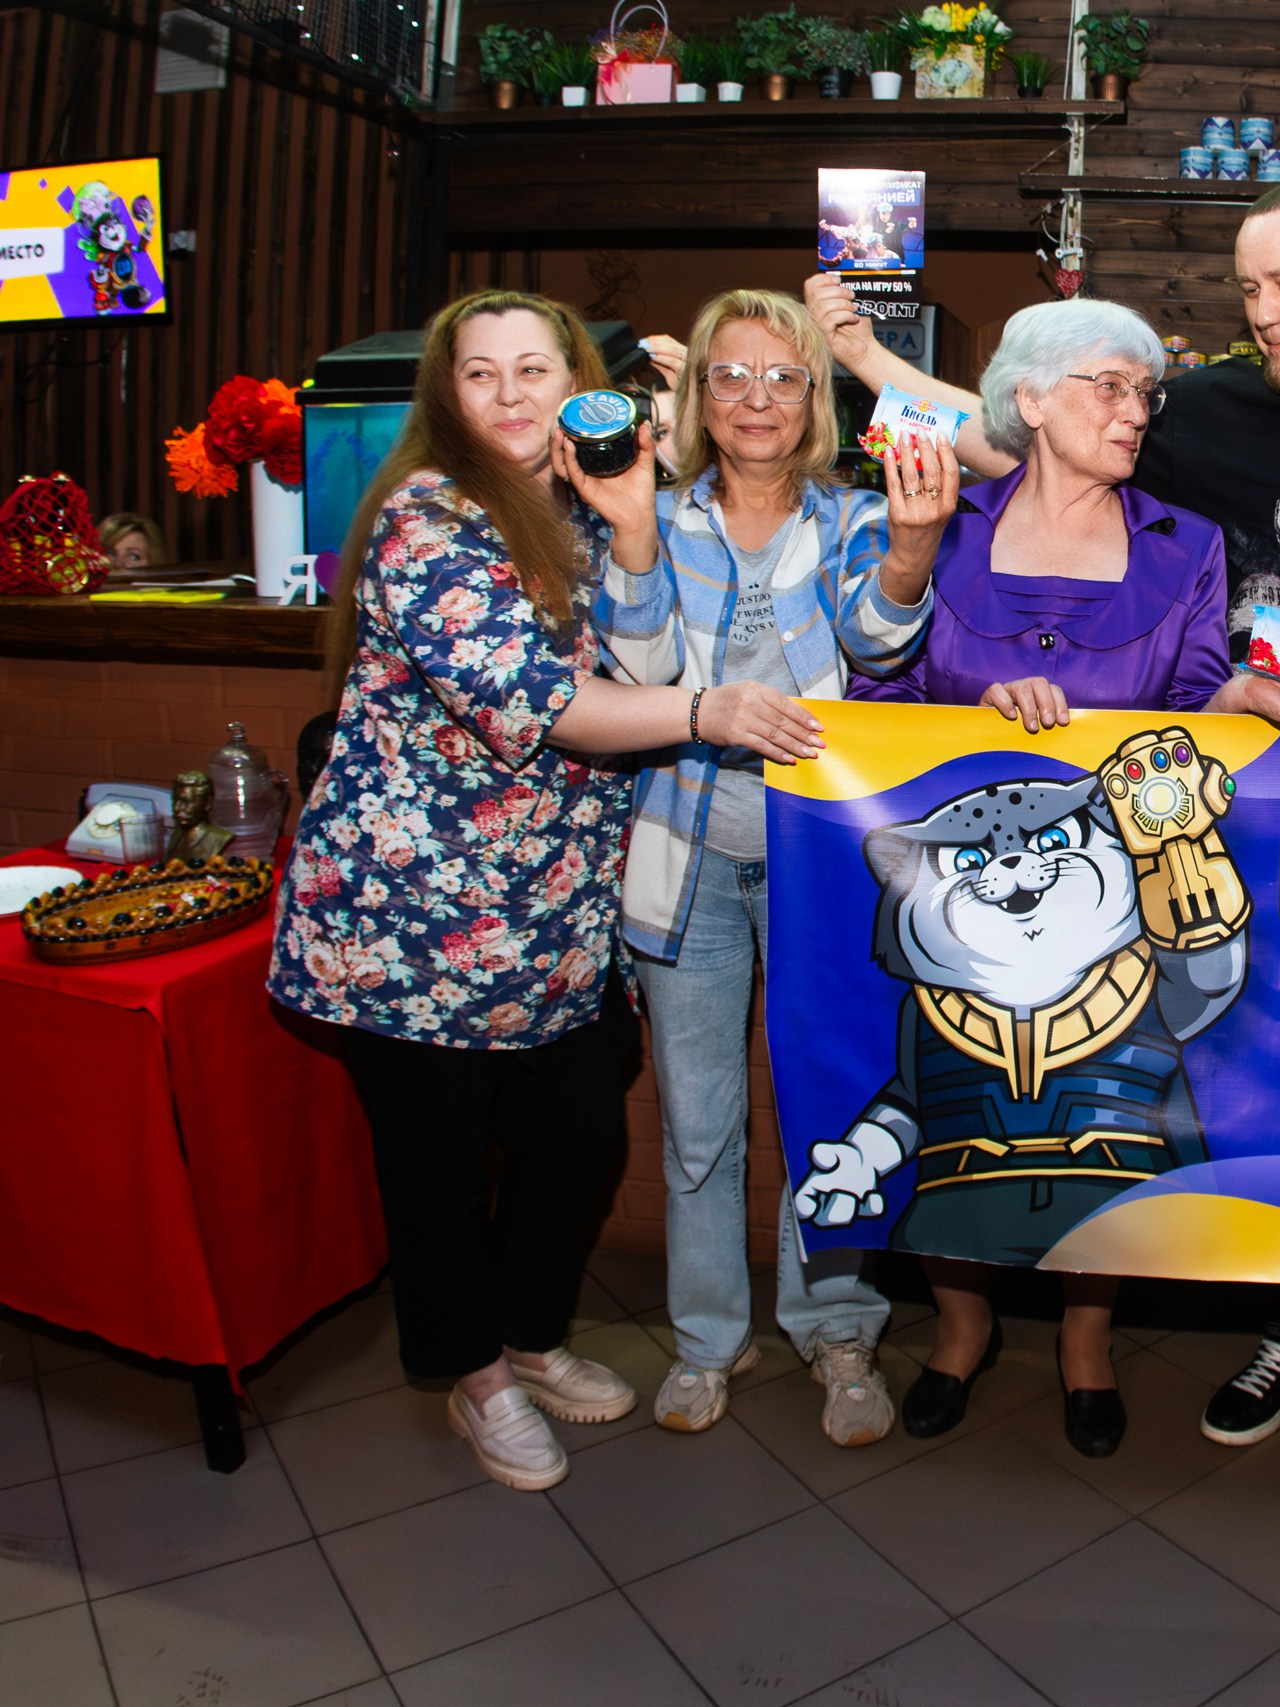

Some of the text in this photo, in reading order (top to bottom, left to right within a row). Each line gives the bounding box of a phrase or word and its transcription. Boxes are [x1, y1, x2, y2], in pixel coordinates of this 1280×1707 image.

[862, 281, 873, 292] НА
[873, 281, 893, 292] ИГРУ
[893, 281, 904, 292] 50
[585, 394, 628, 421] CAVIAR
